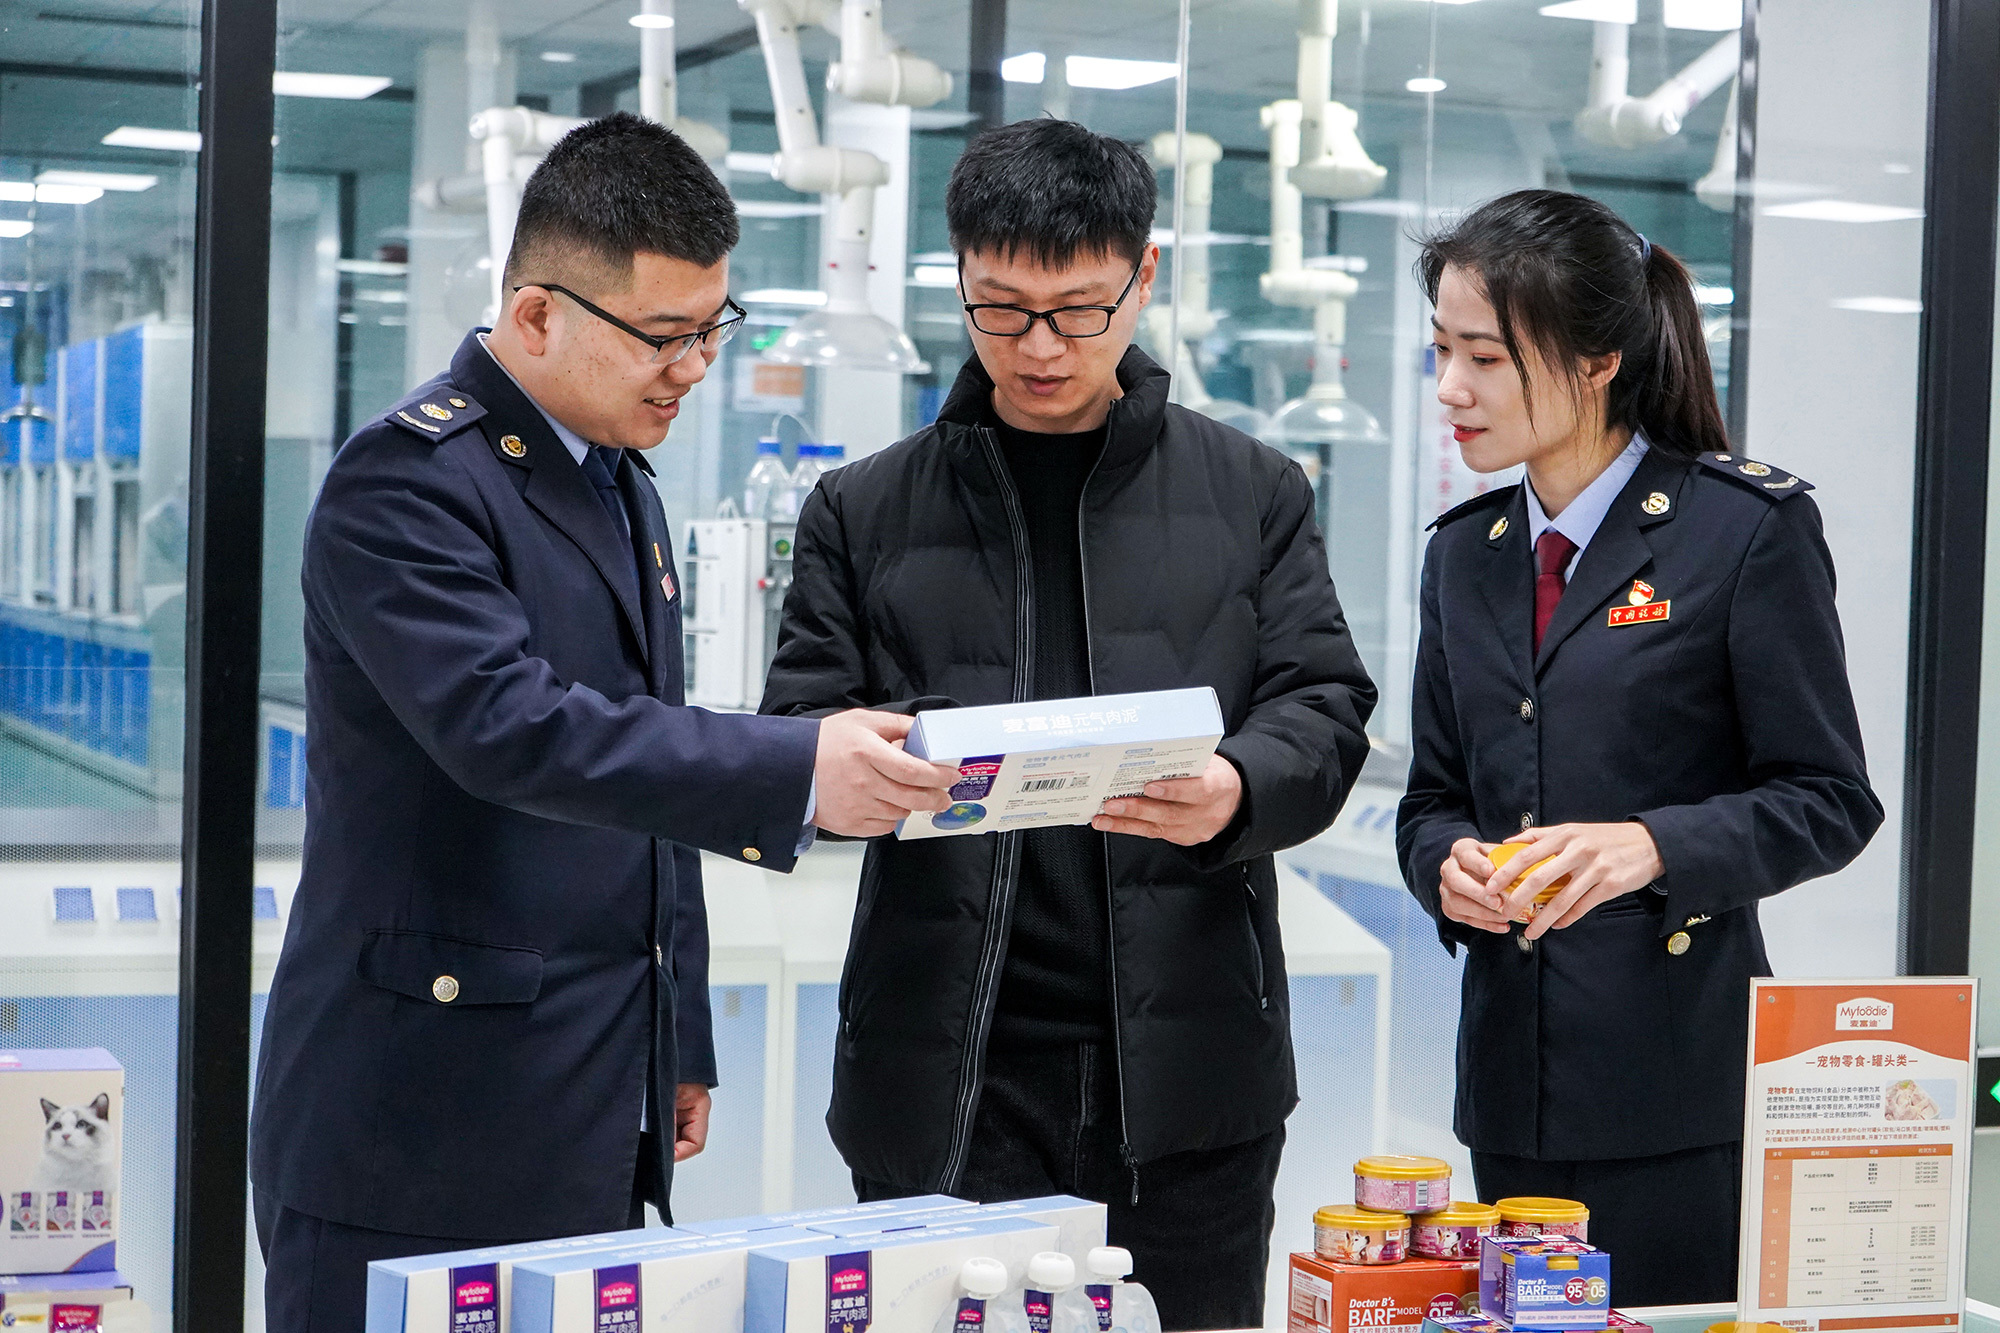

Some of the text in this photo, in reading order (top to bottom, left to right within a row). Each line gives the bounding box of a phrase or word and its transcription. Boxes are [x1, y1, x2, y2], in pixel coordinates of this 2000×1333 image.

[1002, 708, 1139, 733] 麦富迪元气肉泥
[1840, 1005, 1888, 1016] Myfoodie
[1517, 1285, 1547, 1295] BARF
[1567, 1285, 1583, 1298] 95
[1590, 1285, 1606, 1298] 05
[831, 1295, 866, 1310] 麦富迪
[1349, 1297, 1395, 1308] Doctor B's
[455, 1310, 494, 1324] 麦富迪
[599, 1310, 636, 1324] 麦富迪
[829, 1307, 868, 1324] 元气肉泥
[1348, 1306, 1423, 1326] BARF MODEL
